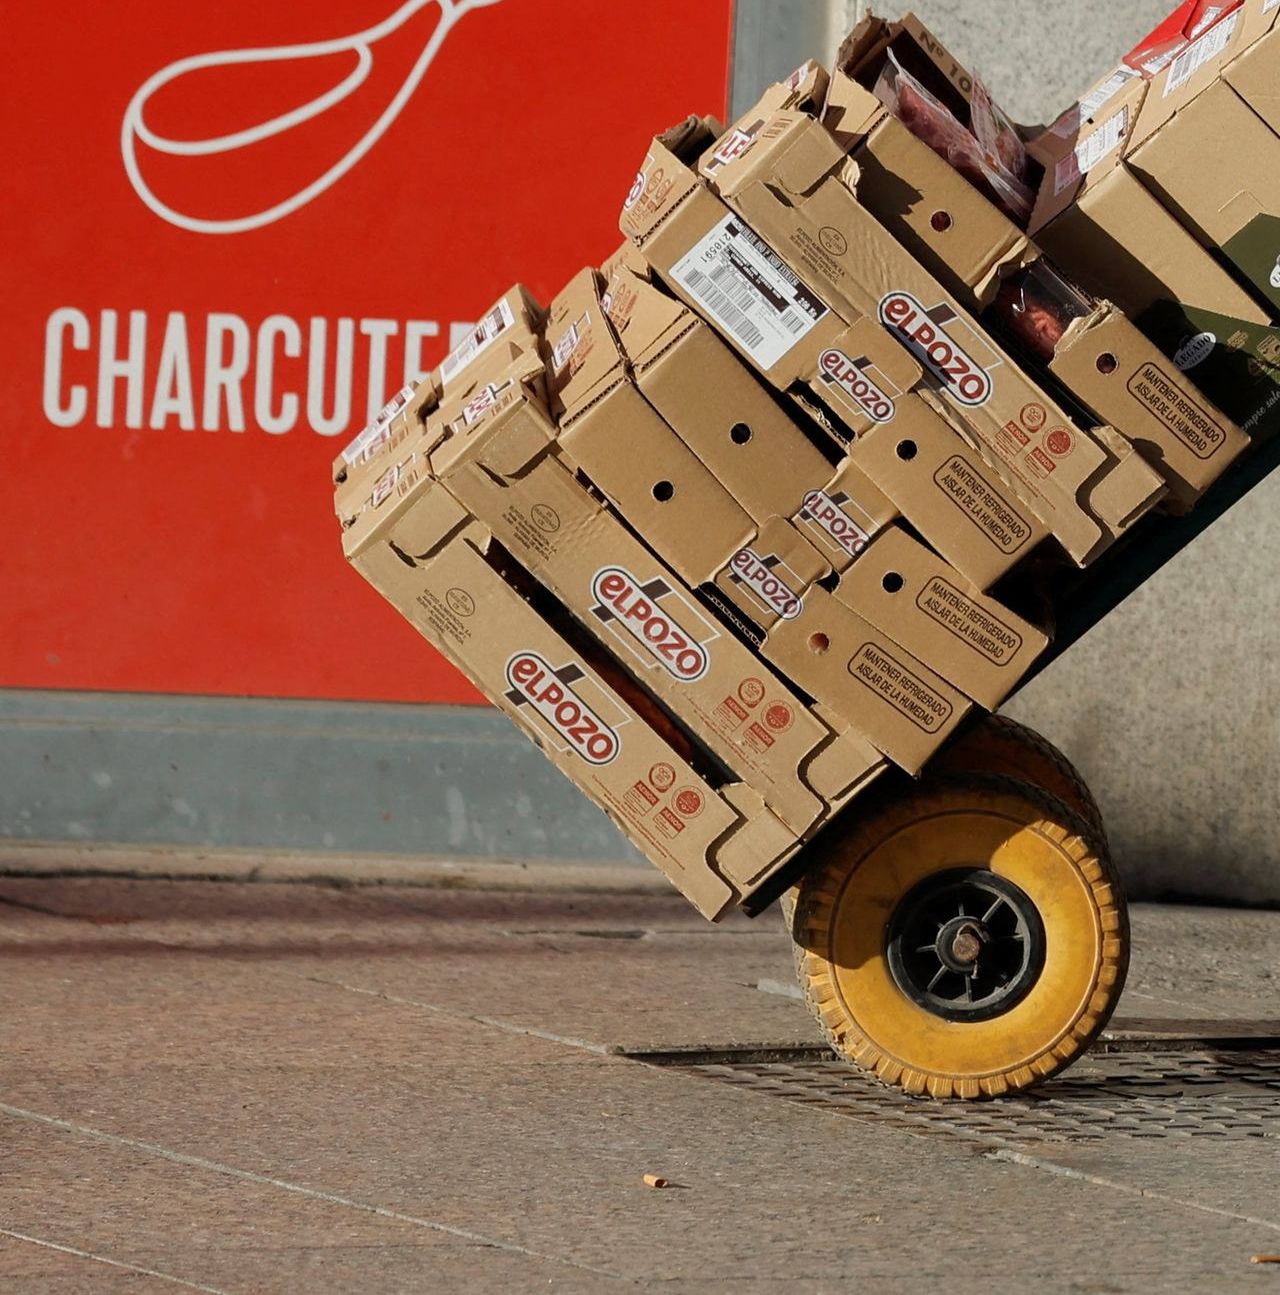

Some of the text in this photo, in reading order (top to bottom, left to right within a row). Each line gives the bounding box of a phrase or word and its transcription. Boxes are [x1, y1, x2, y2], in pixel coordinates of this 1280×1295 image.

[1134, 382, 1207, 451] AISLAR DE LA HUMEDAD
[1142, 368, 1219, 443] MANTENER REFRIGERADO
[941, 474, 1012, 546] AISLAR DE LA HUMEDAD
[949, 461, 985, 498] MANTENER
[981, 493, 1025, 539] REFRIGERADO
[924, 597, 1004, 659] AISLAR DE LA HUMEDAD
[930, 582, 1016, 649] MANTENER REFRIGERADO
[855, 662, 934, 726] AISLAR DE LA HUMEDAD
[862, 648, 947, 717] MANTENER REFRIGERADO
